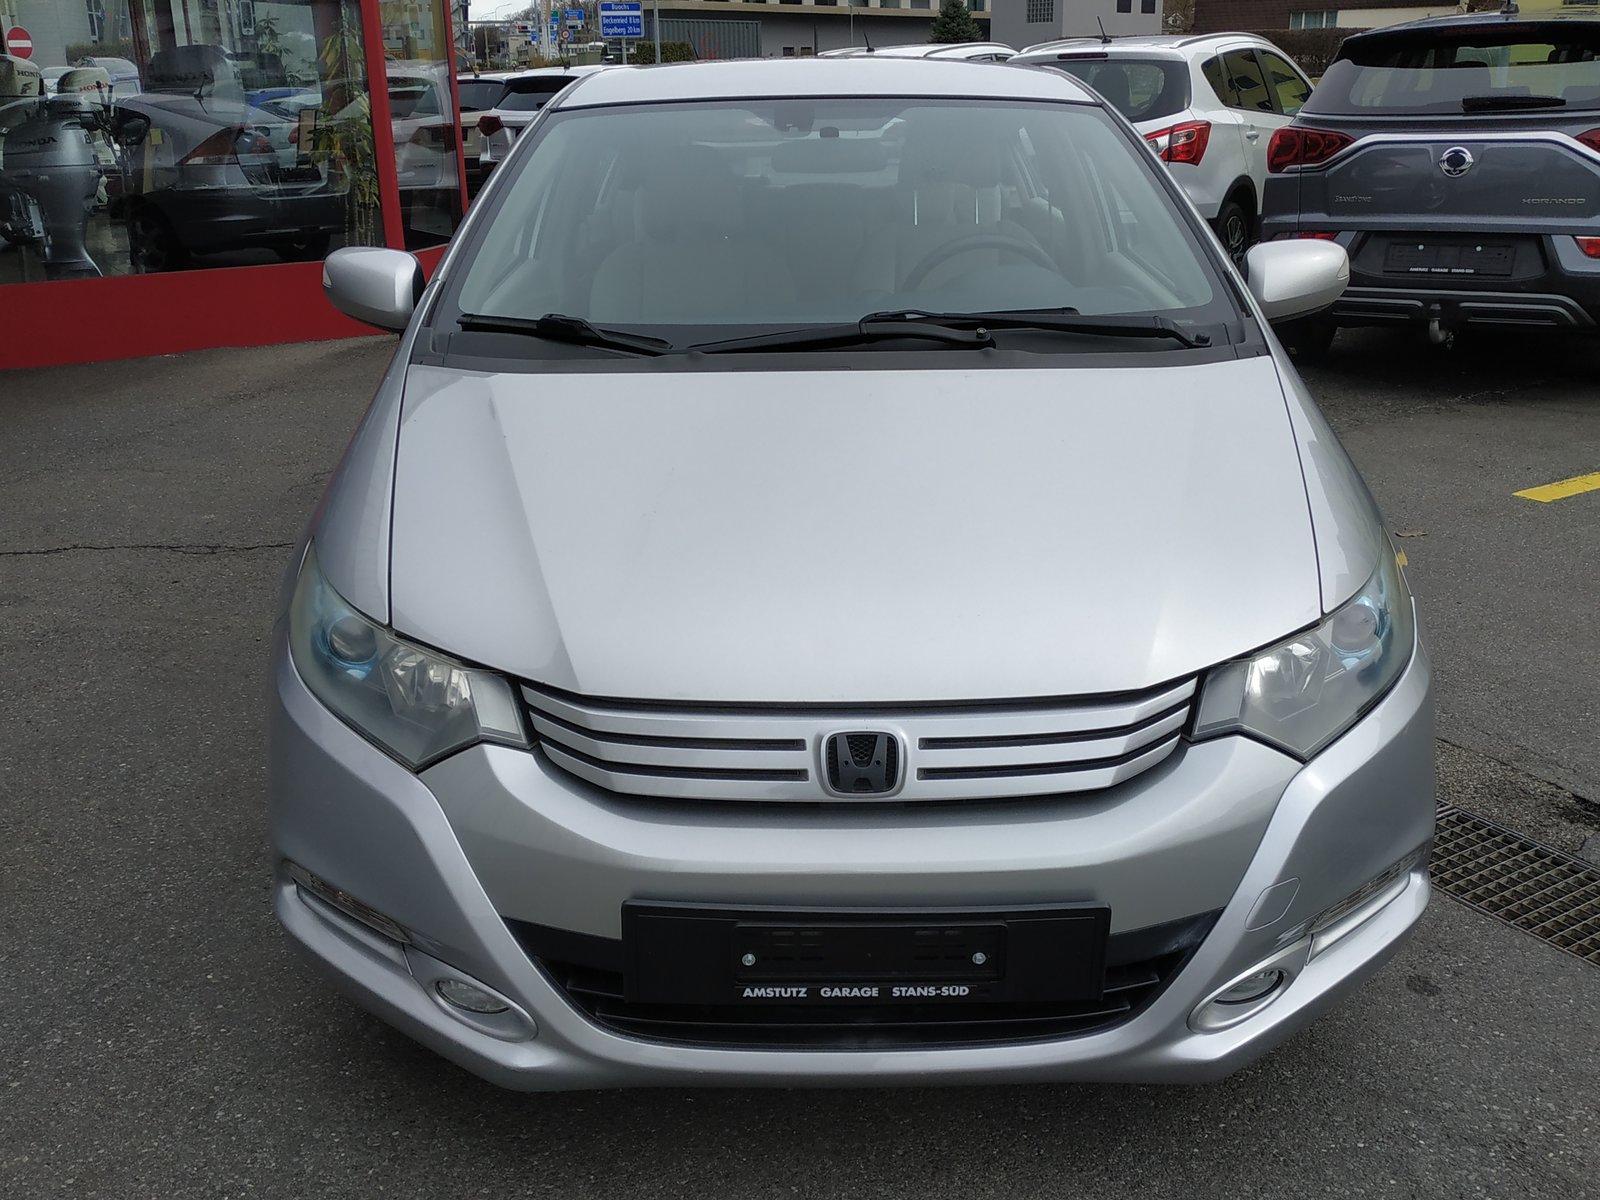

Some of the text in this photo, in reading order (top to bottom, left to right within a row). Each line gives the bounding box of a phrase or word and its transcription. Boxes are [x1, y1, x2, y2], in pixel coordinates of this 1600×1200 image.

[602, 16, 628, 24] Beckenried
[633, 16, 640, 24] km
[603, 26, 626, 35] Engelberg
[742, 985, 969, 998] AMSTUTZ GARAGE STANS-SÜD
